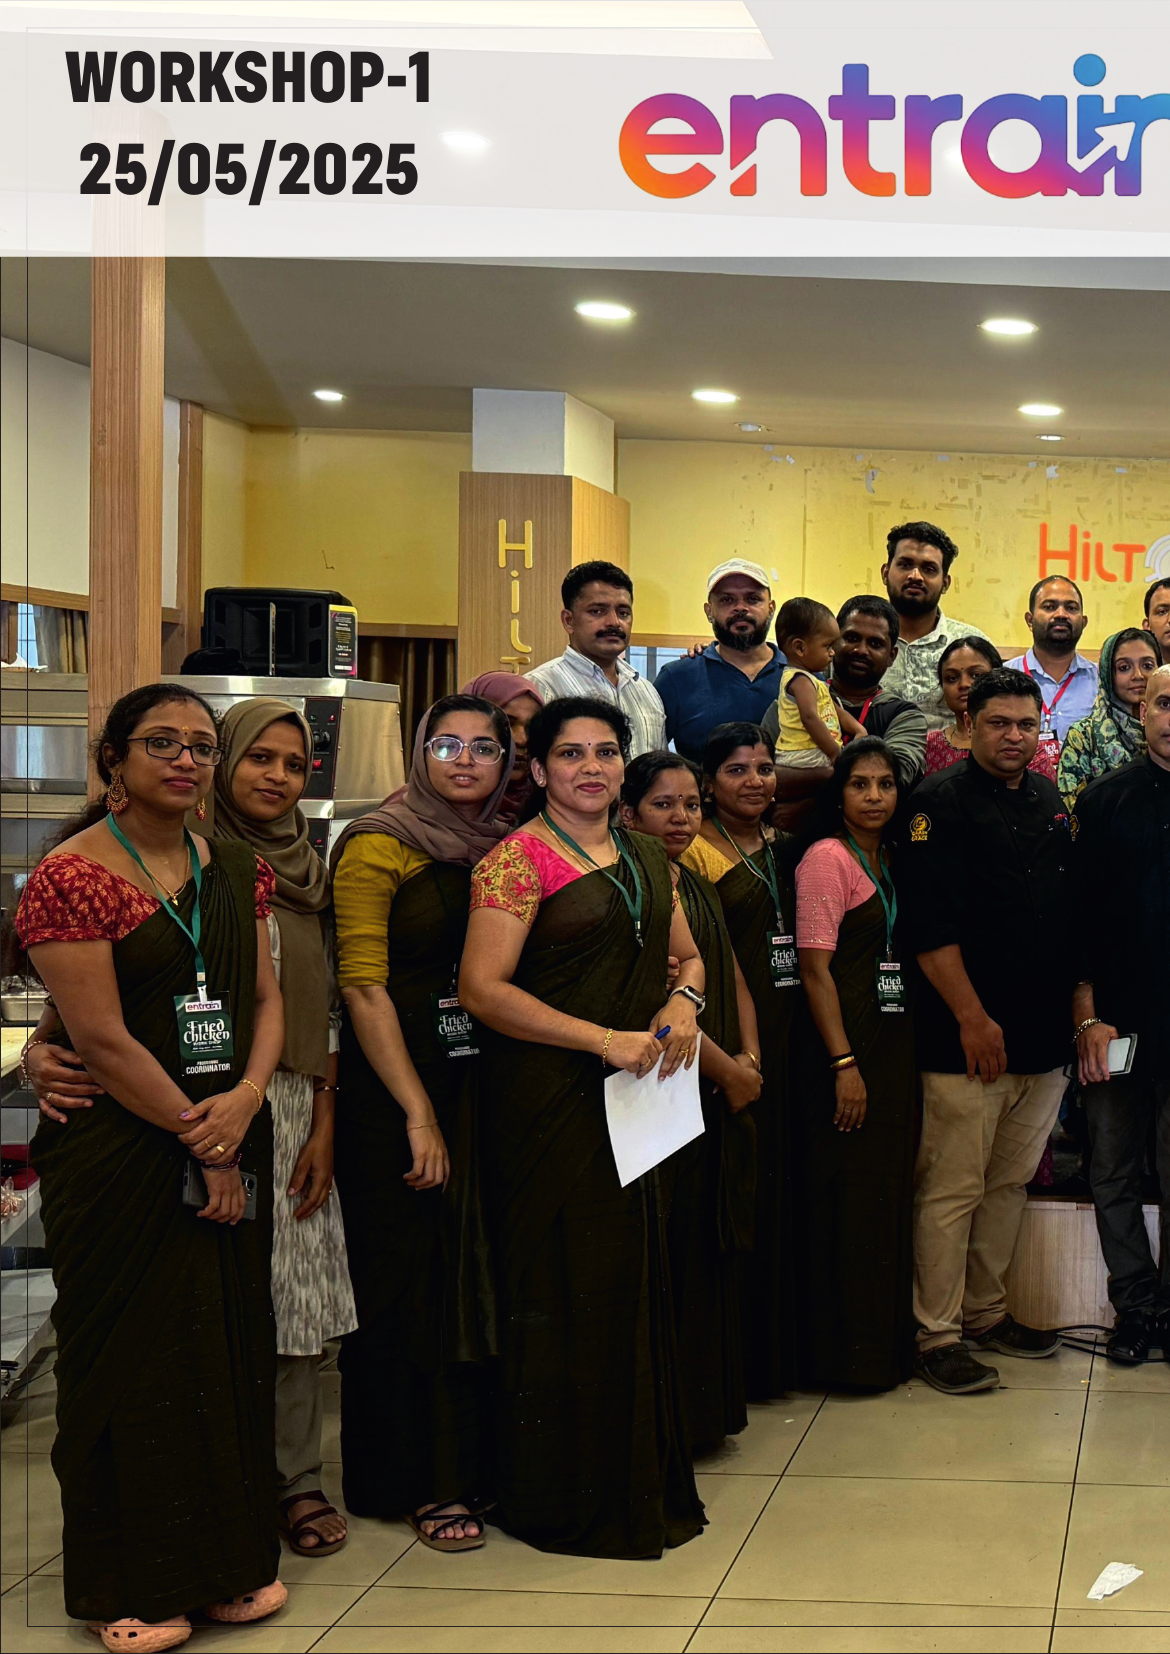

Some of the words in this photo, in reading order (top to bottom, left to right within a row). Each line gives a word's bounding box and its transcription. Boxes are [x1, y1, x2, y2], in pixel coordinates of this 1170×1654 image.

[187, 1002, 220, 1011] entrain
[186, 1019, 225, 1033] Fried
[183, 1031, 230, 1044] Chicken
[186, 1063, 231, 1074] COORDINATOR
